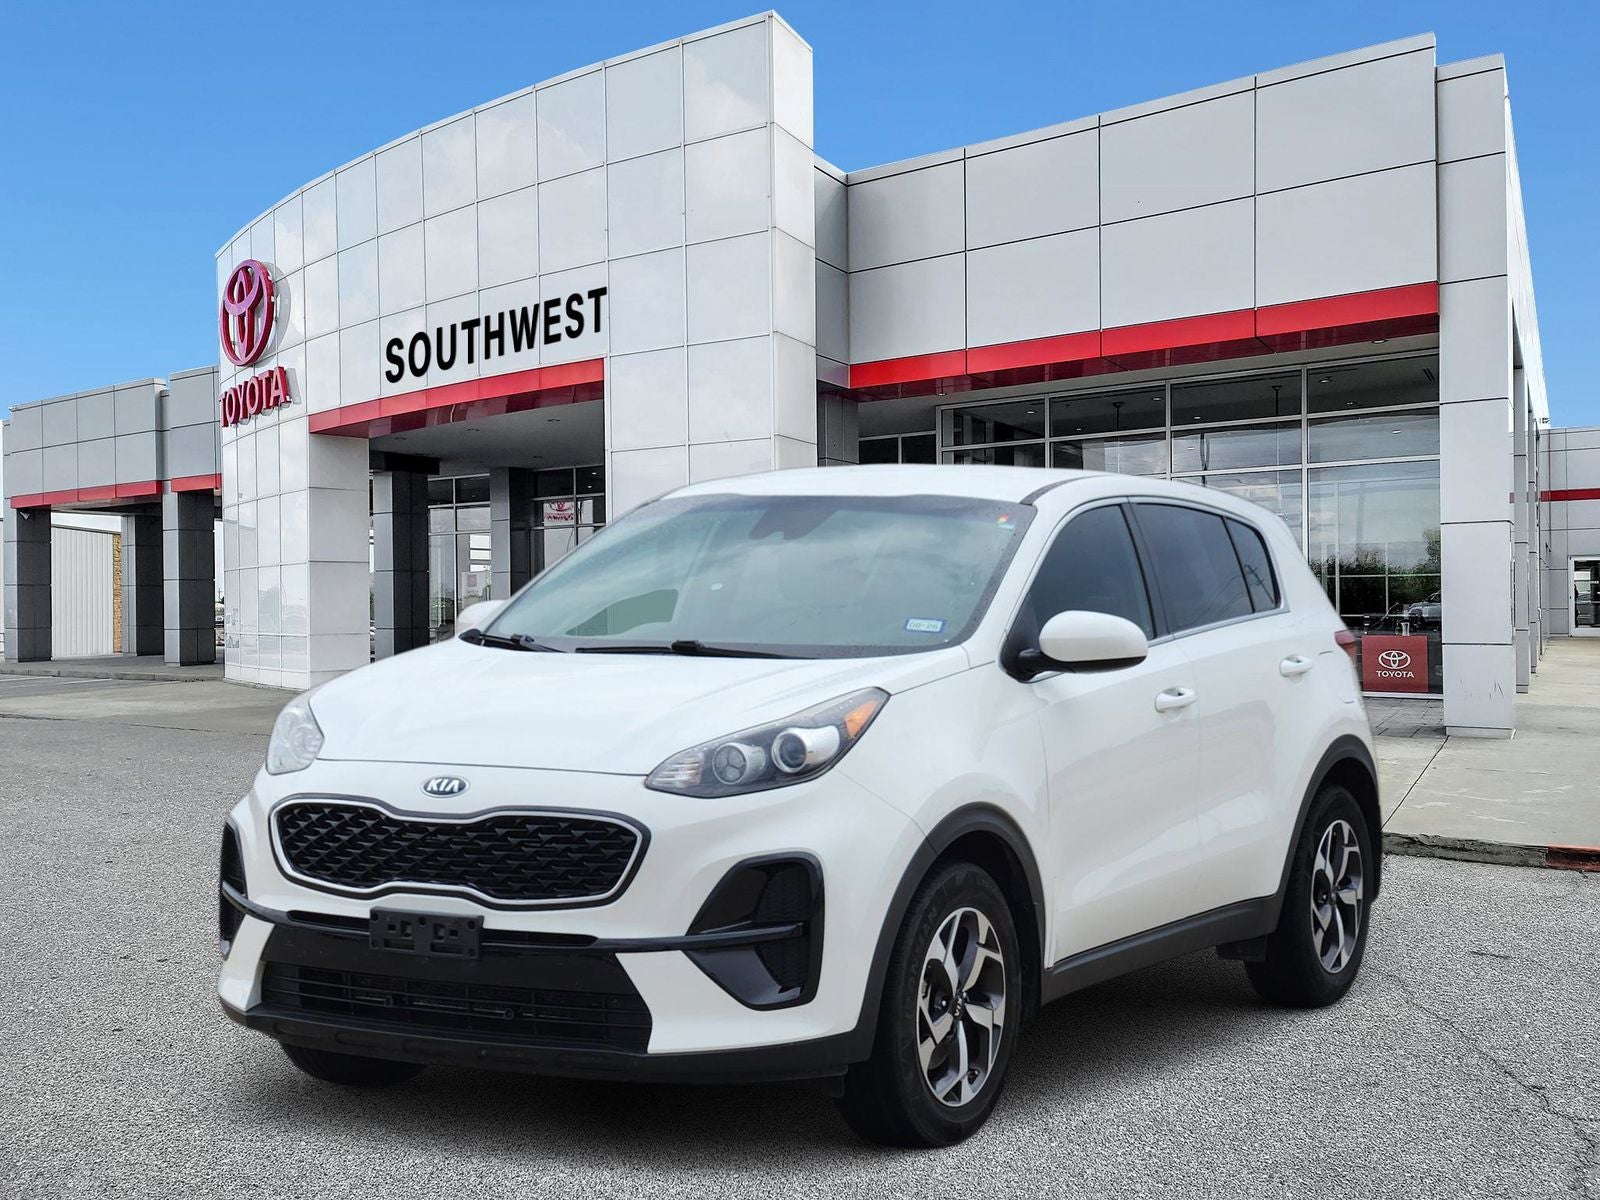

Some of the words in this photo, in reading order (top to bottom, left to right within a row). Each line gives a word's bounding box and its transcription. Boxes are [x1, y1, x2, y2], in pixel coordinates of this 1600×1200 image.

[385, 286, 607, 383] SOUTHWEST
[218, 366, 289, 428] TOYOTA
[1376, 670, 1414, 678] TOYOTA
[426, 778, 459, 792] KIA
